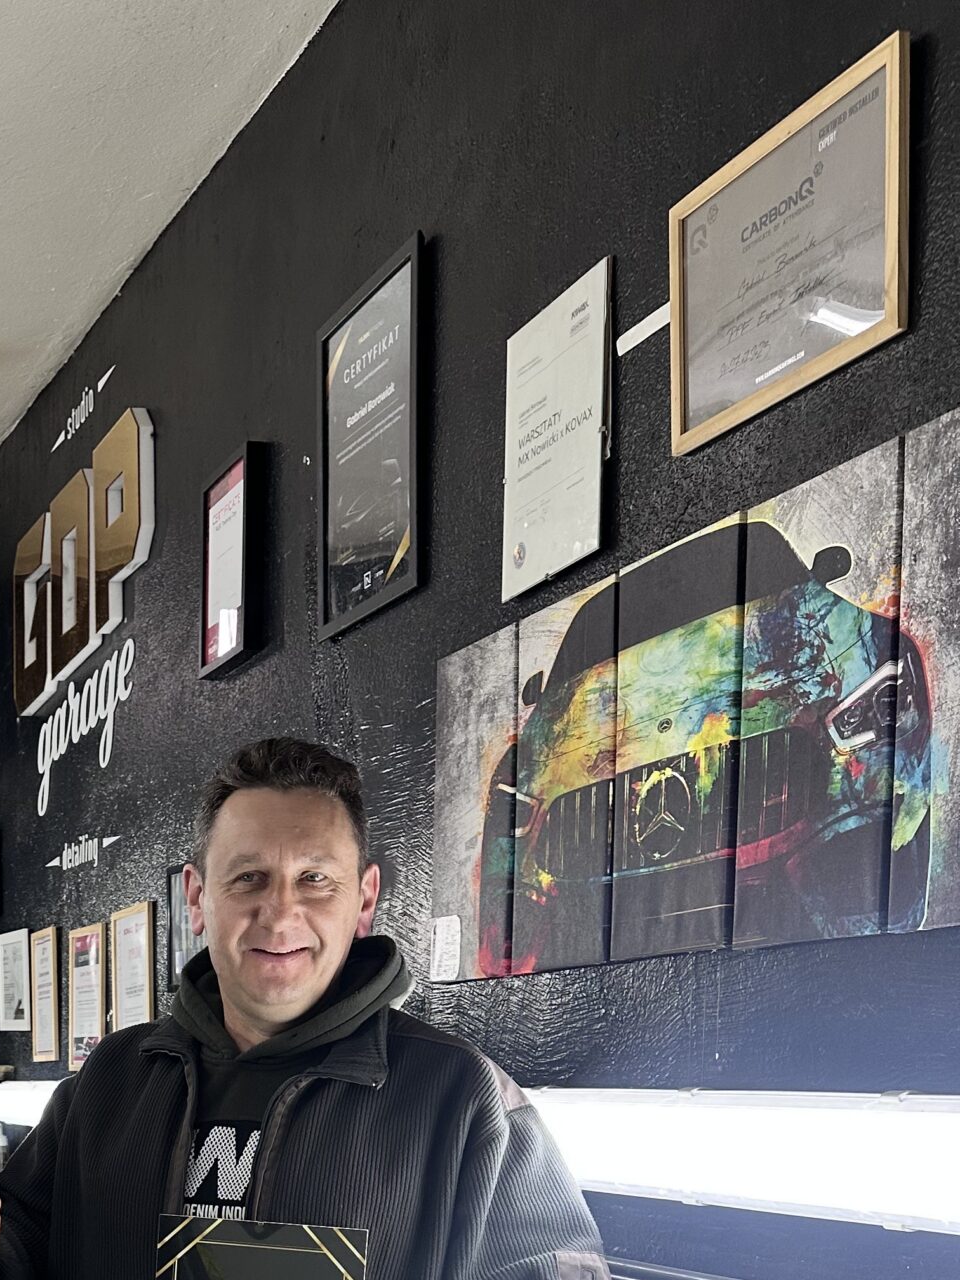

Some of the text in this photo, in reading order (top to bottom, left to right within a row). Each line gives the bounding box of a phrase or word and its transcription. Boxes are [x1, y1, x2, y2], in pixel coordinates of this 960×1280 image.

[741, 176, 815, 243] CARBONQ
[343, 325, 401, 384] CERTYFIKAT
[66, 386, 94, 440] studio
[517, 451, 530, 468] MX
[530, 430, 559, 461] Nowicki
[565, 406, 594, 432] KOVAX
[518, 409, 563, 450] WARSZTATY
[13, 407, 155, 718] GDP
[36, 638, 135, 816] garage
[62, 834, 99, 871] detailing
